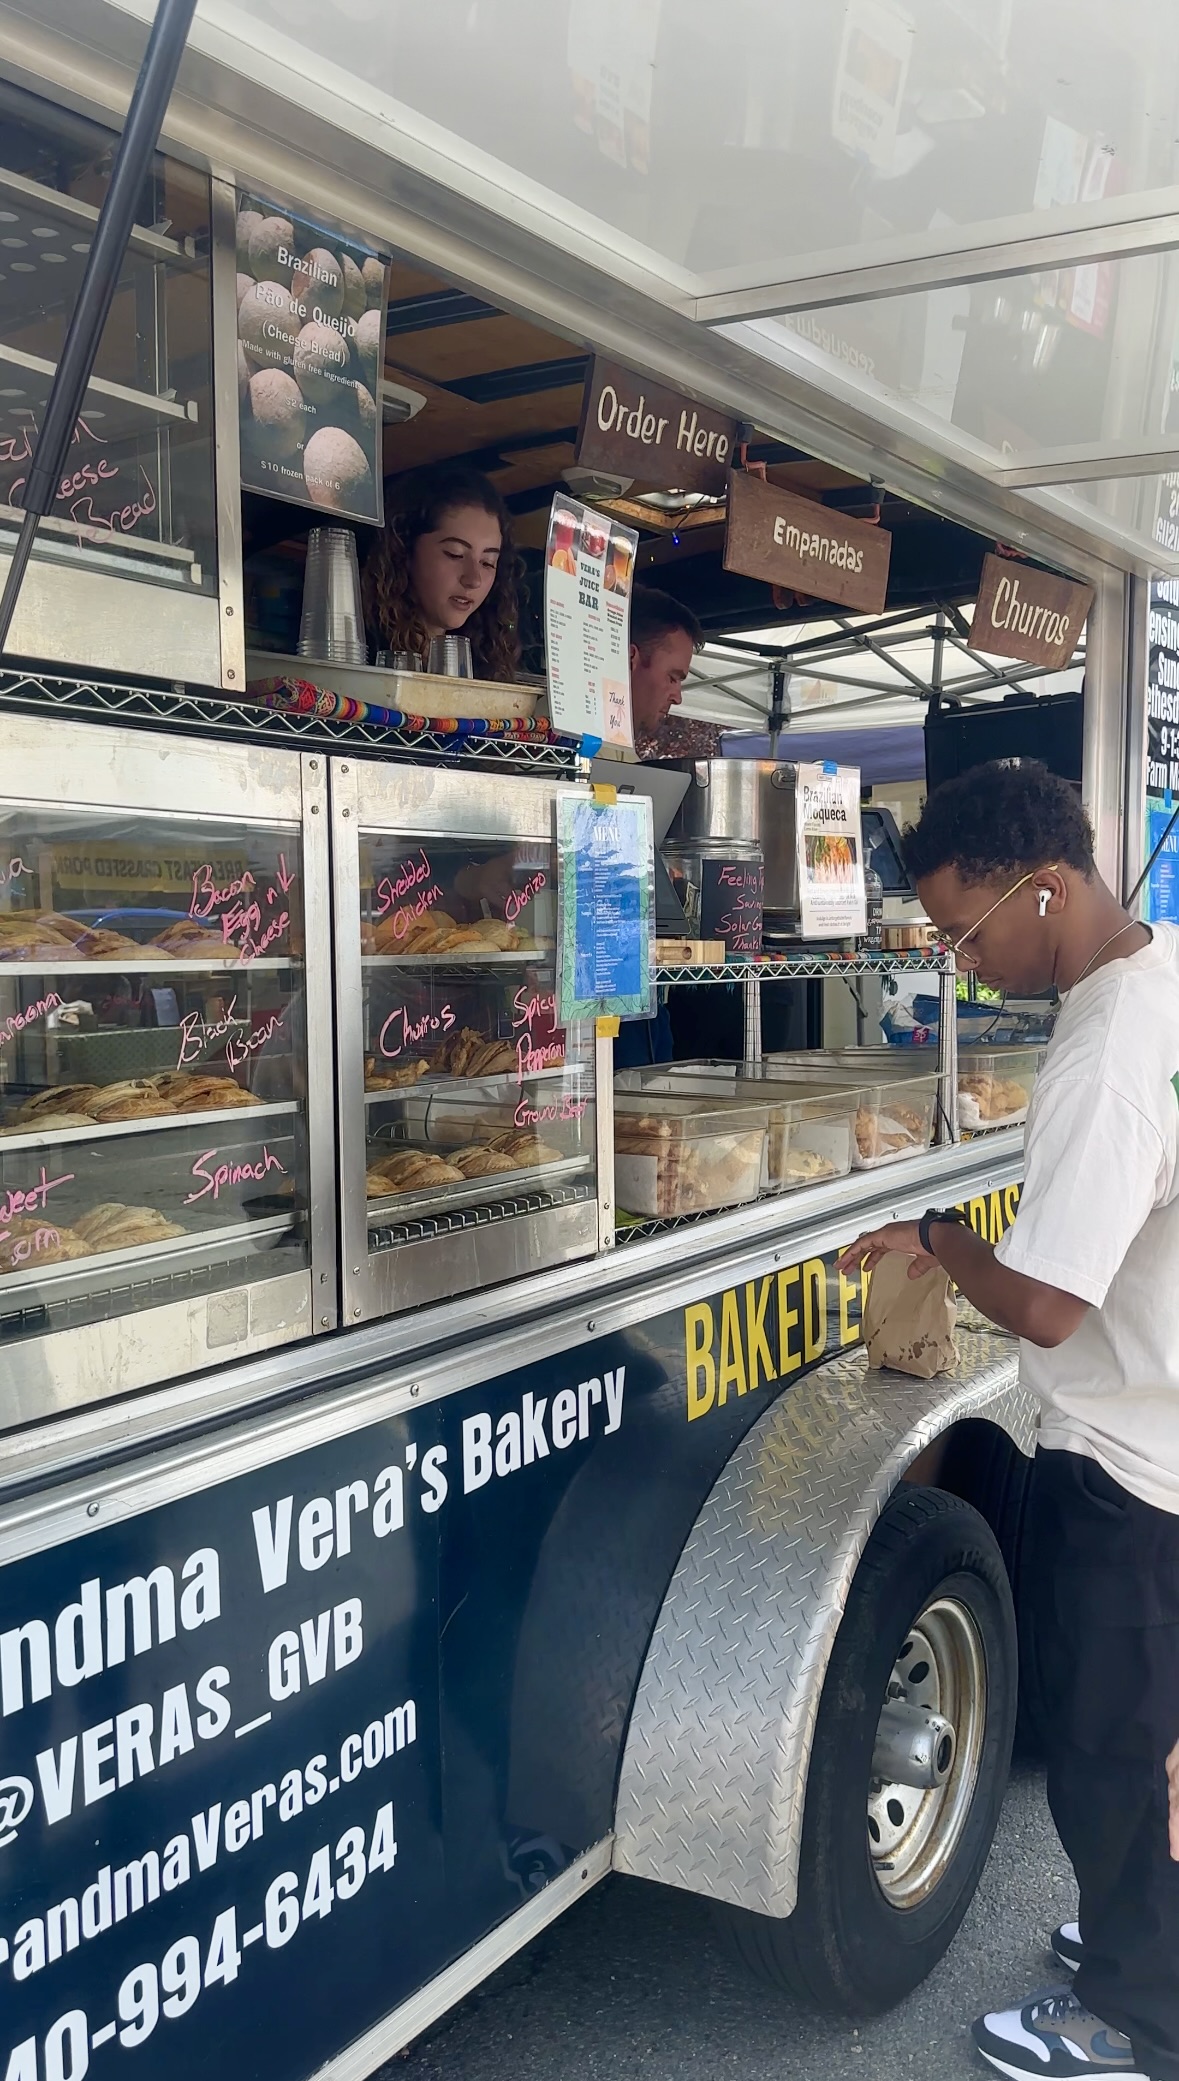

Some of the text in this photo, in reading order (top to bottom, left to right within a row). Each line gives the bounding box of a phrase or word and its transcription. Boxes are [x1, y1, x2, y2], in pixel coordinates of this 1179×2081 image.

[277, 246, 338, 287] Brazilian
[289, 298, 307, 318] de
[312, 306, 356, 338] Queijo
[241, 339, 263, 354] Made
[265, 348, 281, 361] with
[308, 365, 322, 376] free
[262, 319, 346, 368] (Cheese Bread)
[299, 402, 317, 415] each
[597, 385, 729, 464] Order Here
[296, 442, 305, 451] or
[8, 458, 119, 509] Ceese
[281, 465, 303, 480] frozen
[334, 481, 341, 490] 6
[773, 515, 864, 574] Empanadas
[579, 576, 599, 592] JUICE
[580, 562, 601, 578] VERA'S
[578, 591, 599, 611] BAR
[991, 576, 1070, 646] Churros
[188, 864, 257, 919] Bacon
[393, 884, 444, 939] Chicken
[504, 872, 546, 921] Chorizo
[512, 985, 558, 1034] Spicy
[183, 1146, 288, 1204] Spinach
[684, 1257, 828, 1423] BAKED
[252, 1443, 449, 1594] Vera's
[462, 1366, 626, 1495] Bakery
